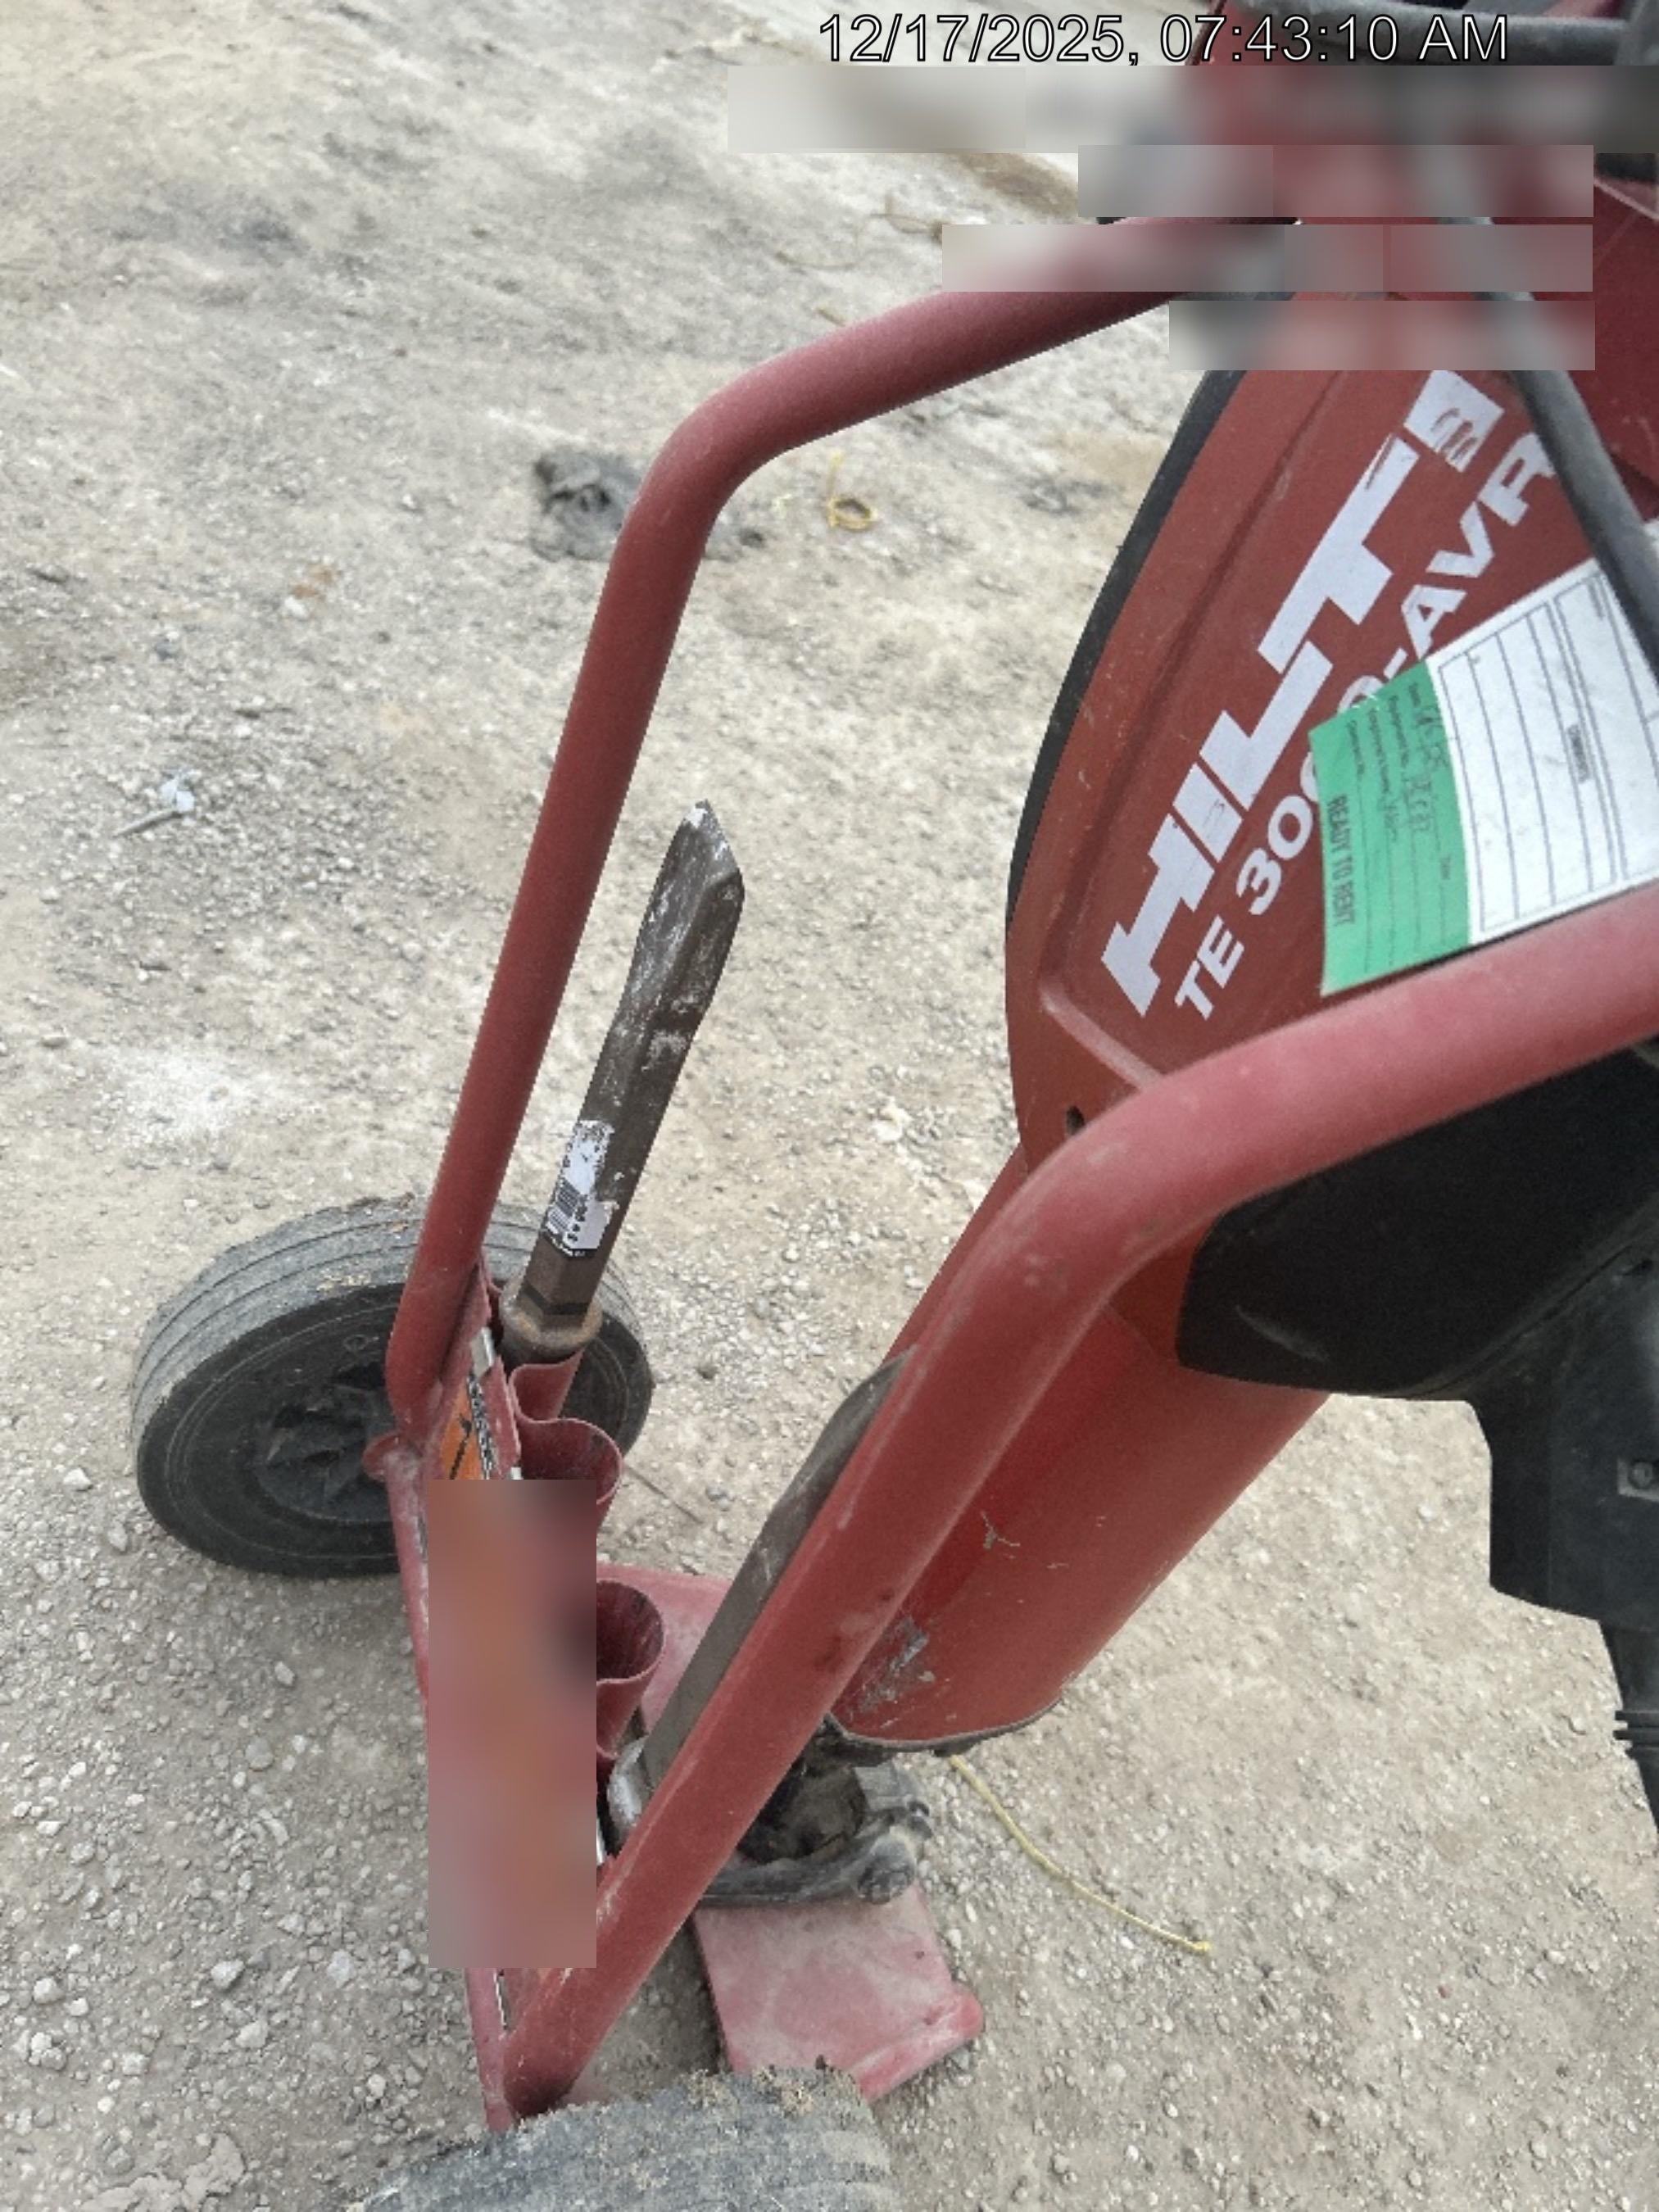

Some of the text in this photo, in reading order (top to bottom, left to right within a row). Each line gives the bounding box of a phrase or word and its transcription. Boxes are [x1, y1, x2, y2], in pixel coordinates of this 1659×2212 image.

[1101, 370, 1504, 1018] HILTI
[1174, 432, 1556, 1020] TE 30-AVR
[1327, 795, 1355, 927] READY TO RENT
